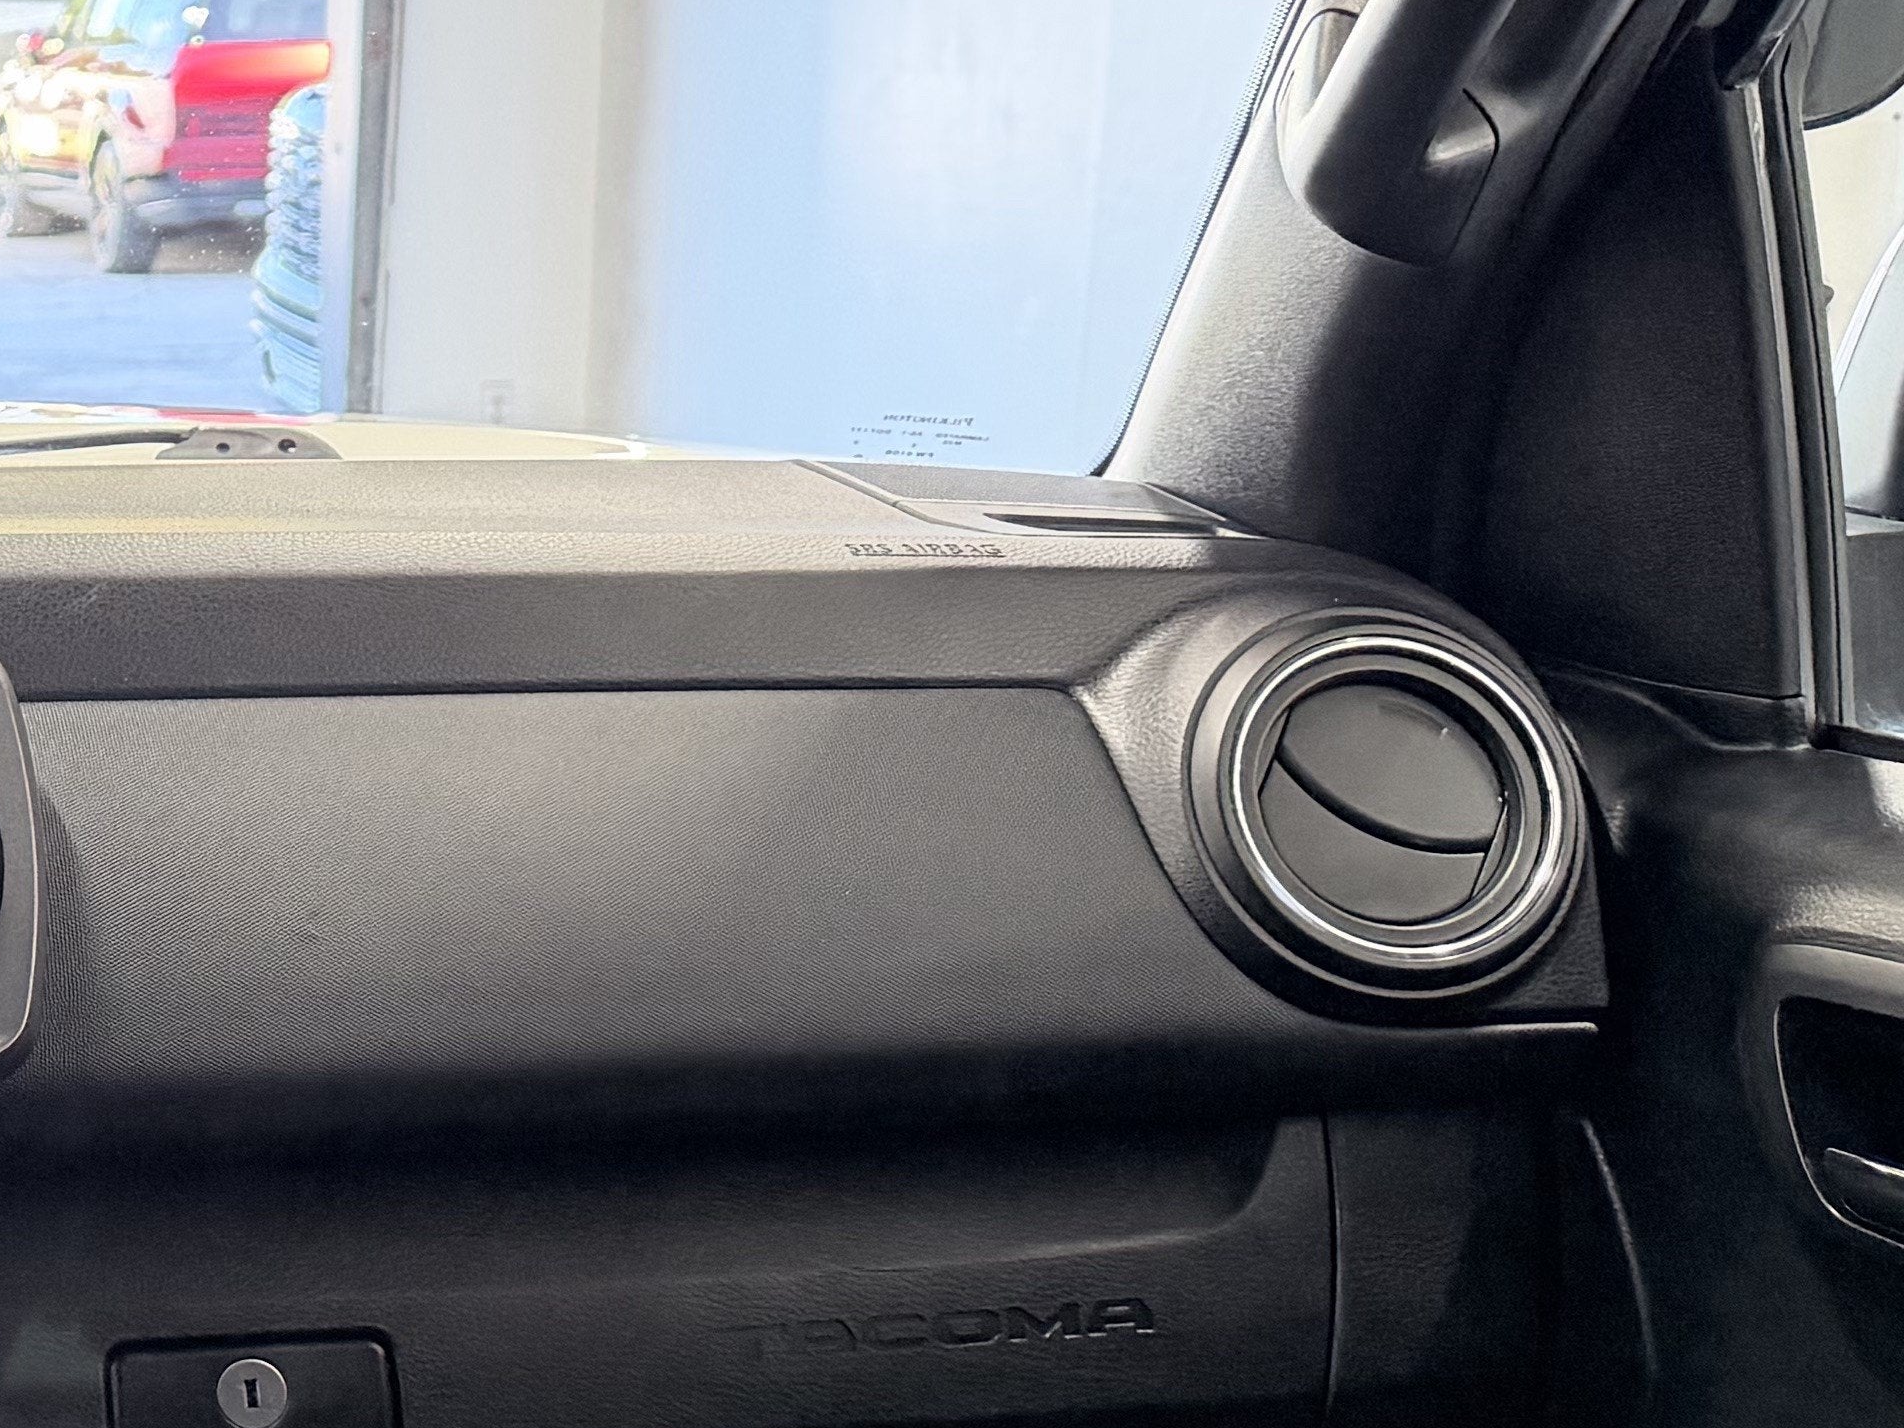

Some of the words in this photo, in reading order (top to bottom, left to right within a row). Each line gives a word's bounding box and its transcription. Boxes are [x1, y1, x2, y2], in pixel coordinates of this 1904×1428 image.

[844, 543, 893, 555] SRS
[901, 543, 1003, 555] AIRBAG
[727, 1298, 1154, 1359] TACOMA
